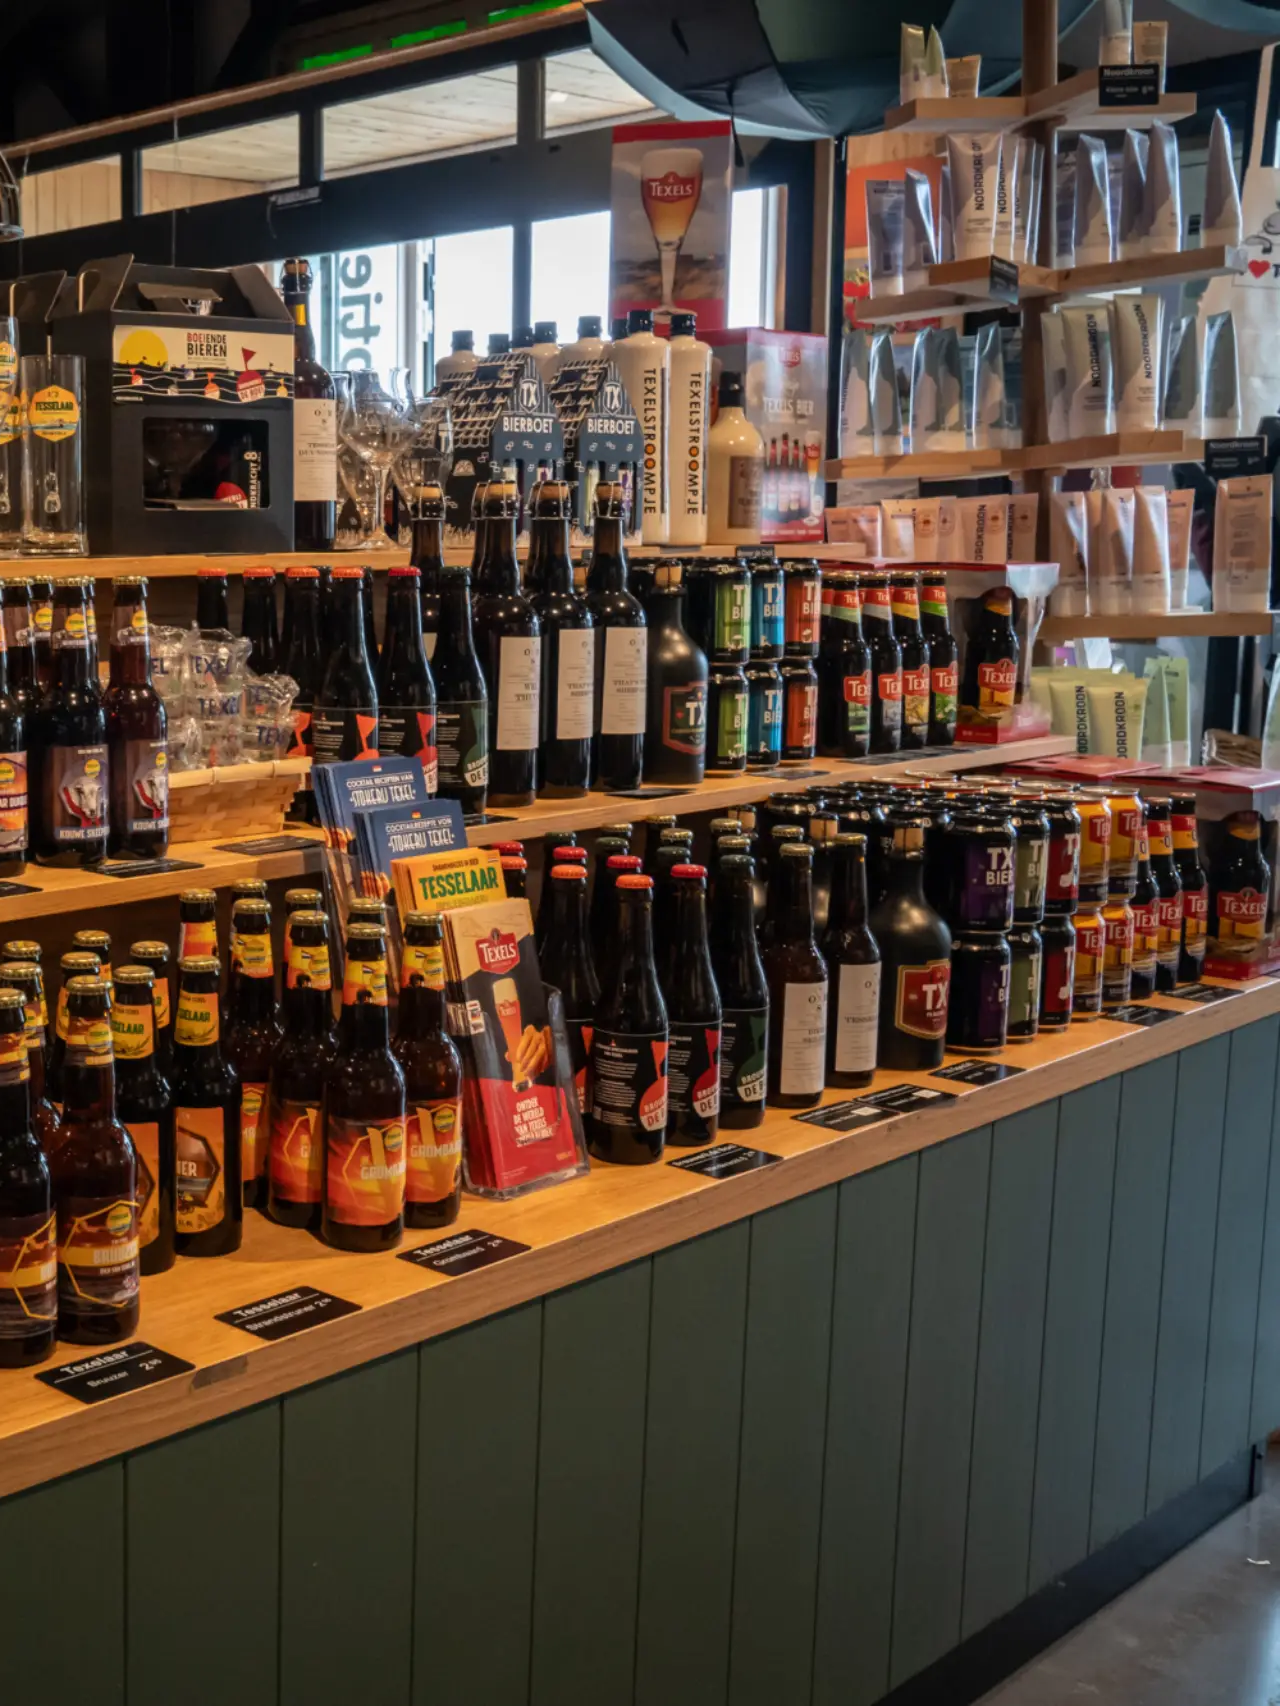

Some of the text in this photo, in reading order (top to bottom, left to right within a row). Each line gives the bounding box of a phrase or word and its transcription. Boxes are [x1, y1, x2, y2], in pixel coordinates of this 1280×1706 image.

[649, 181, 693, 198] TEXELS
[187, 332, 226, 344] BOEIENDE
[187, 343, 227, 357] BIEREN
[1091, 313, 1102, 389] NOORDKROON
[522, 383, 537, 407] TX
[605, 386, 620, 409] TX
[503, 416, 554, 434] BIERBOET
[588, 418, 634, 435] BIERBOET
[643, 368, 657, 515] TEXELSTROOMPJE
[686, 372, 702, 515] TEXELSTROOMPJE
[685, 702, 705, 726] TX
[986, 847, 1013, 870] TX
[418, 866, 499, 900] TESSELAAR
[1222, 896, 1266, 915] TEXELS
[479, 943, 516, 964] TEXELS
[922, 981, 948, 1010] TX
[413, 1233, 473, 1256] Tesselaar
[232, 1292, 303, 1319] Tesselaar
[59, 1349, 129, 1376] Texelaar
